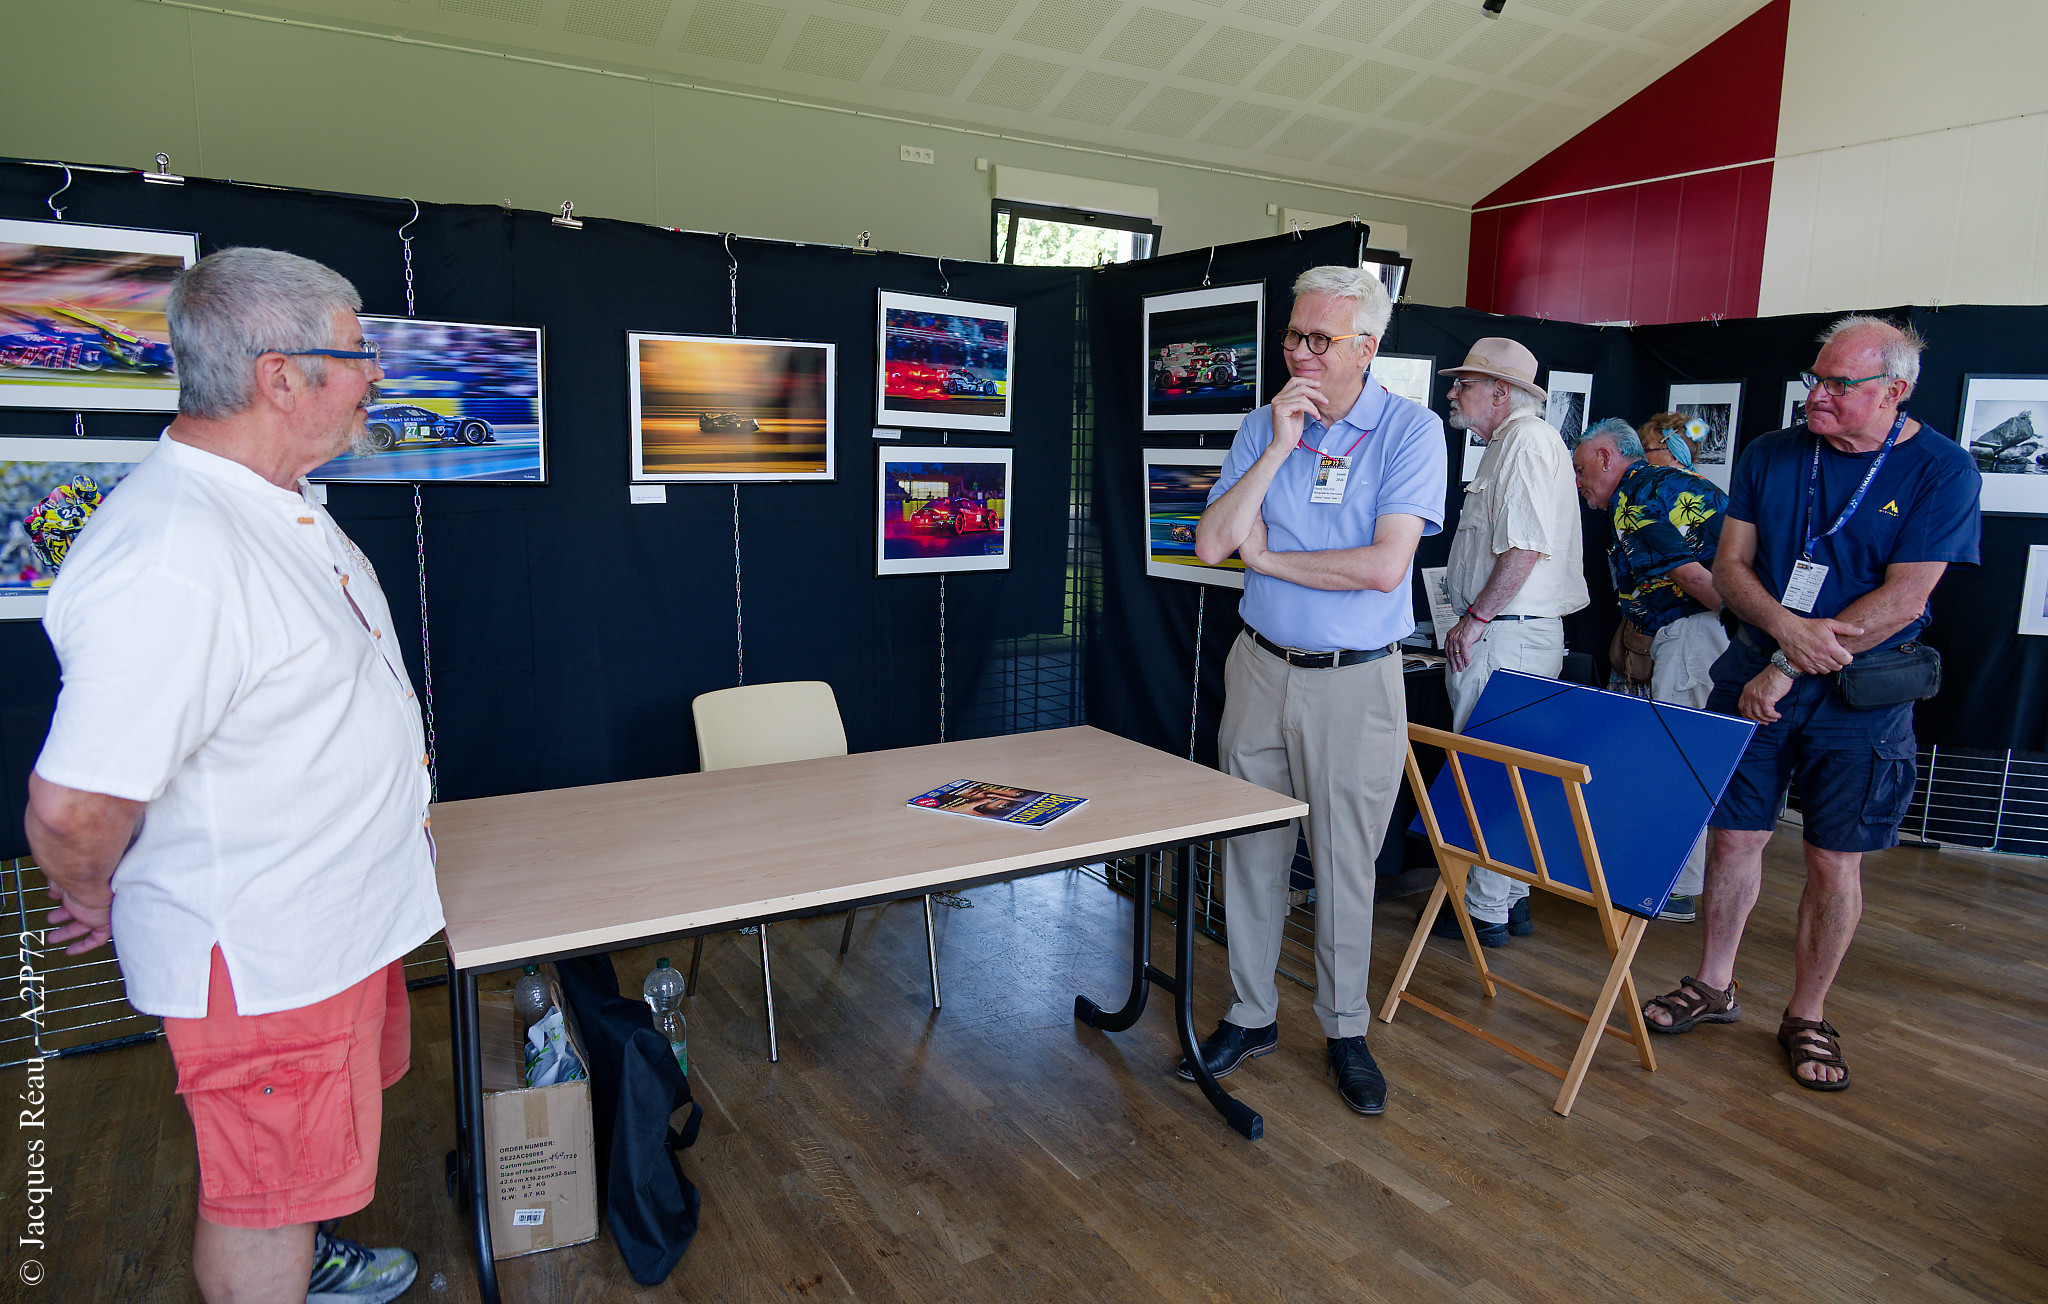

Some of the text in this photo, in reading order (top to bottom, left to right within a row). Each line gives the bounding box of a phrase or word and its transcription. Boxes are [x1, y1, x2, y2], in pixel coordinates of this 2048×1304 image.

[405, 426, 417, 436] 27
[62, 506, 80, 519] 24
[499, 1141, 555, 1154] ORDER NUMBER:
[500, 1162, 522, 1170] Carton
[534, 1164, 557, 1173] carton:
